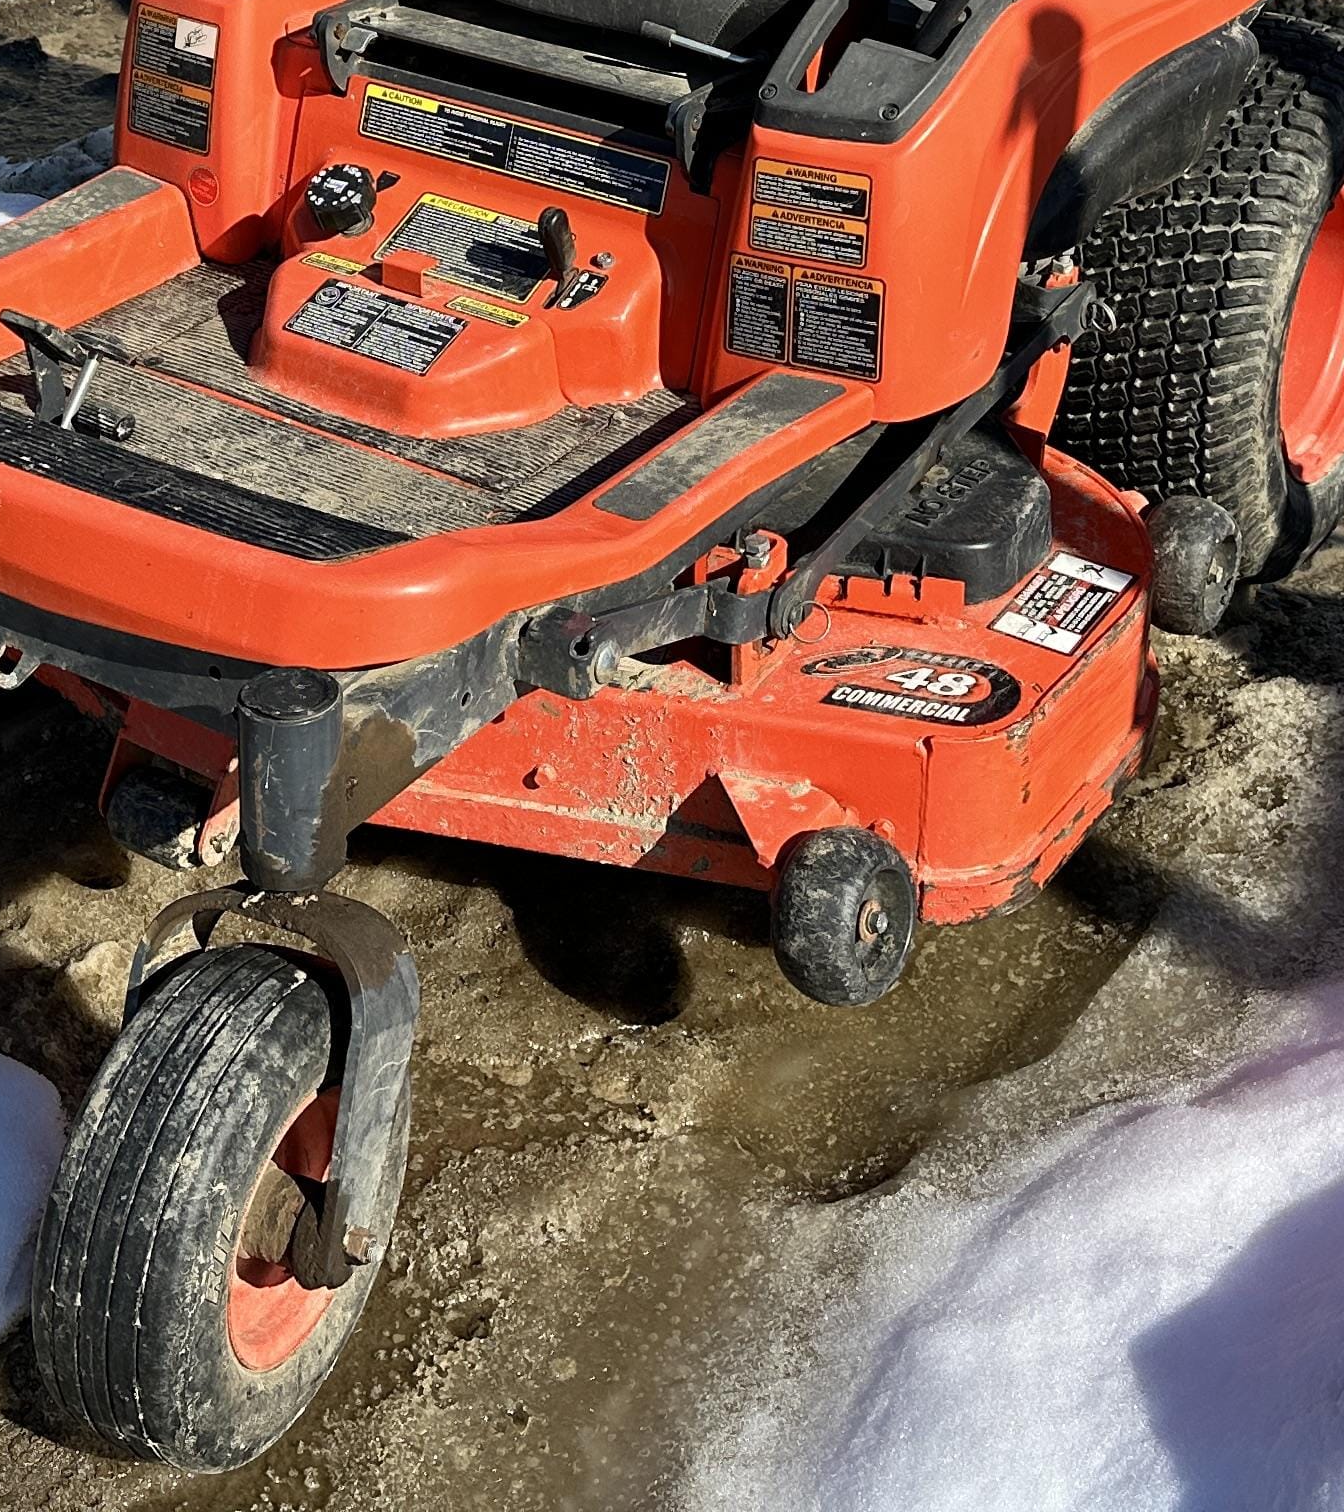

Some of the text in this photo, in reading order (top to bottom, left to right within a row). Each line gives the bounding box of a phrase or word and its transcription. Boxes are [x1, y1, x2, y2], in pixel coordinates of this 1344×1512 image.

[389, 92, 423, 106] CAUTION
[792, 168, 838, 183] WARNING
[780, 213, 846, 230] ADVERTENCIA
[744, 259, 785, 274] WARNING
[336, 281, 382, 298] IMPORTANT
[810, 272, 874, 290] ADVERTENCIA
[405, 303, 456, 324] IMPORTANTE
[905, 459, 993, 527] NO STEP
[1019, 573, 1048, 602] DANGER
[1058, 586, 1087, 615] PELIGRO
[886, 666, 977, 697] 48
[831, 687, 972, 722] COMMERCIAL
